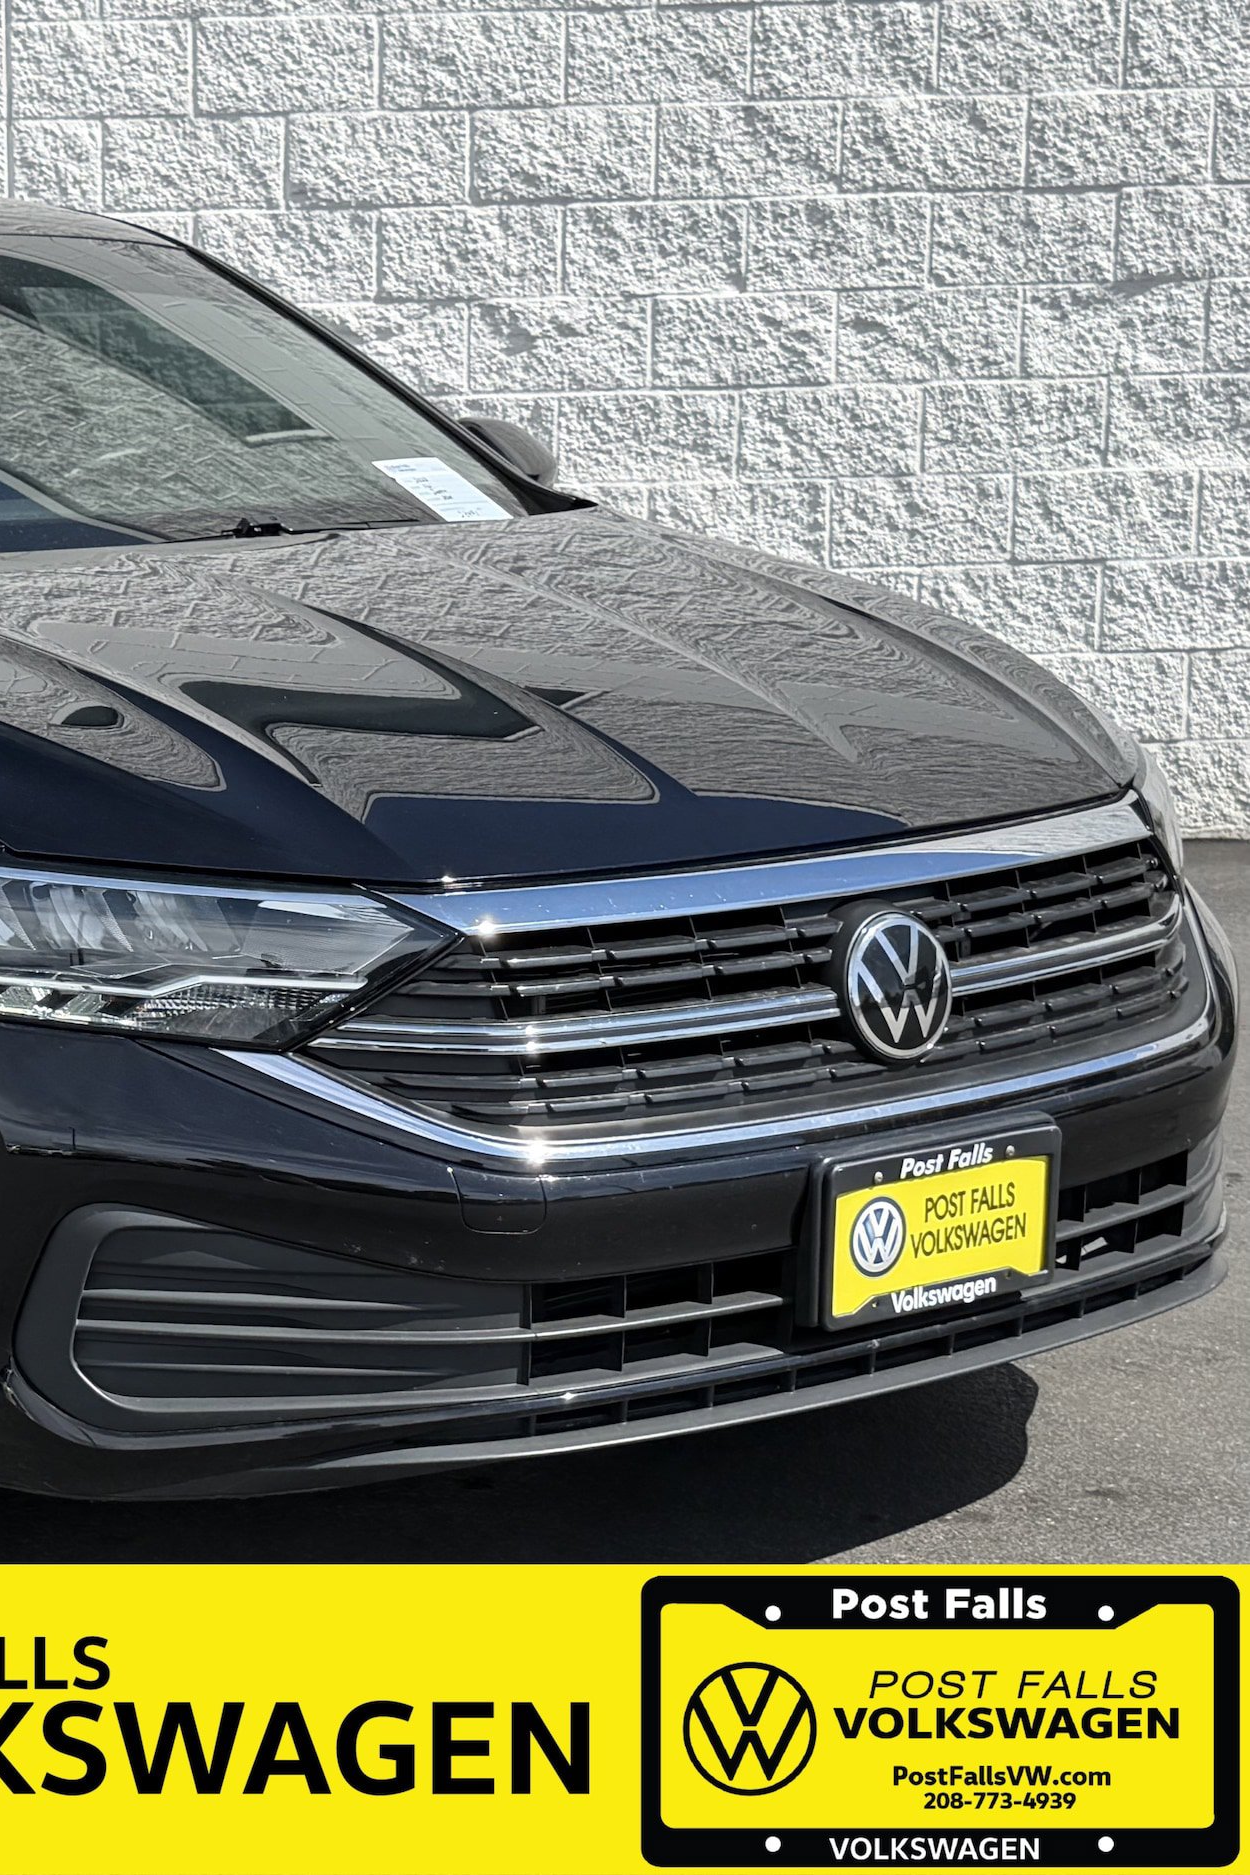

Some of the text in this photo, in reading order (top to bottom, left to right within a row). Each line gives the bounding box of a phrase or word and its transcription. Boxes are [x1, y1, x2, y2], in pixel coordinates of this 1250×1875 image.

[900, 1142, 993, 1179] Post Falls
[925, 1182, 1015, 1223] POST FALLS
[910, 1213, 1027, 1259] VOLKSWAGEN
[891, 1276, 997, 1314] Volkswagen
